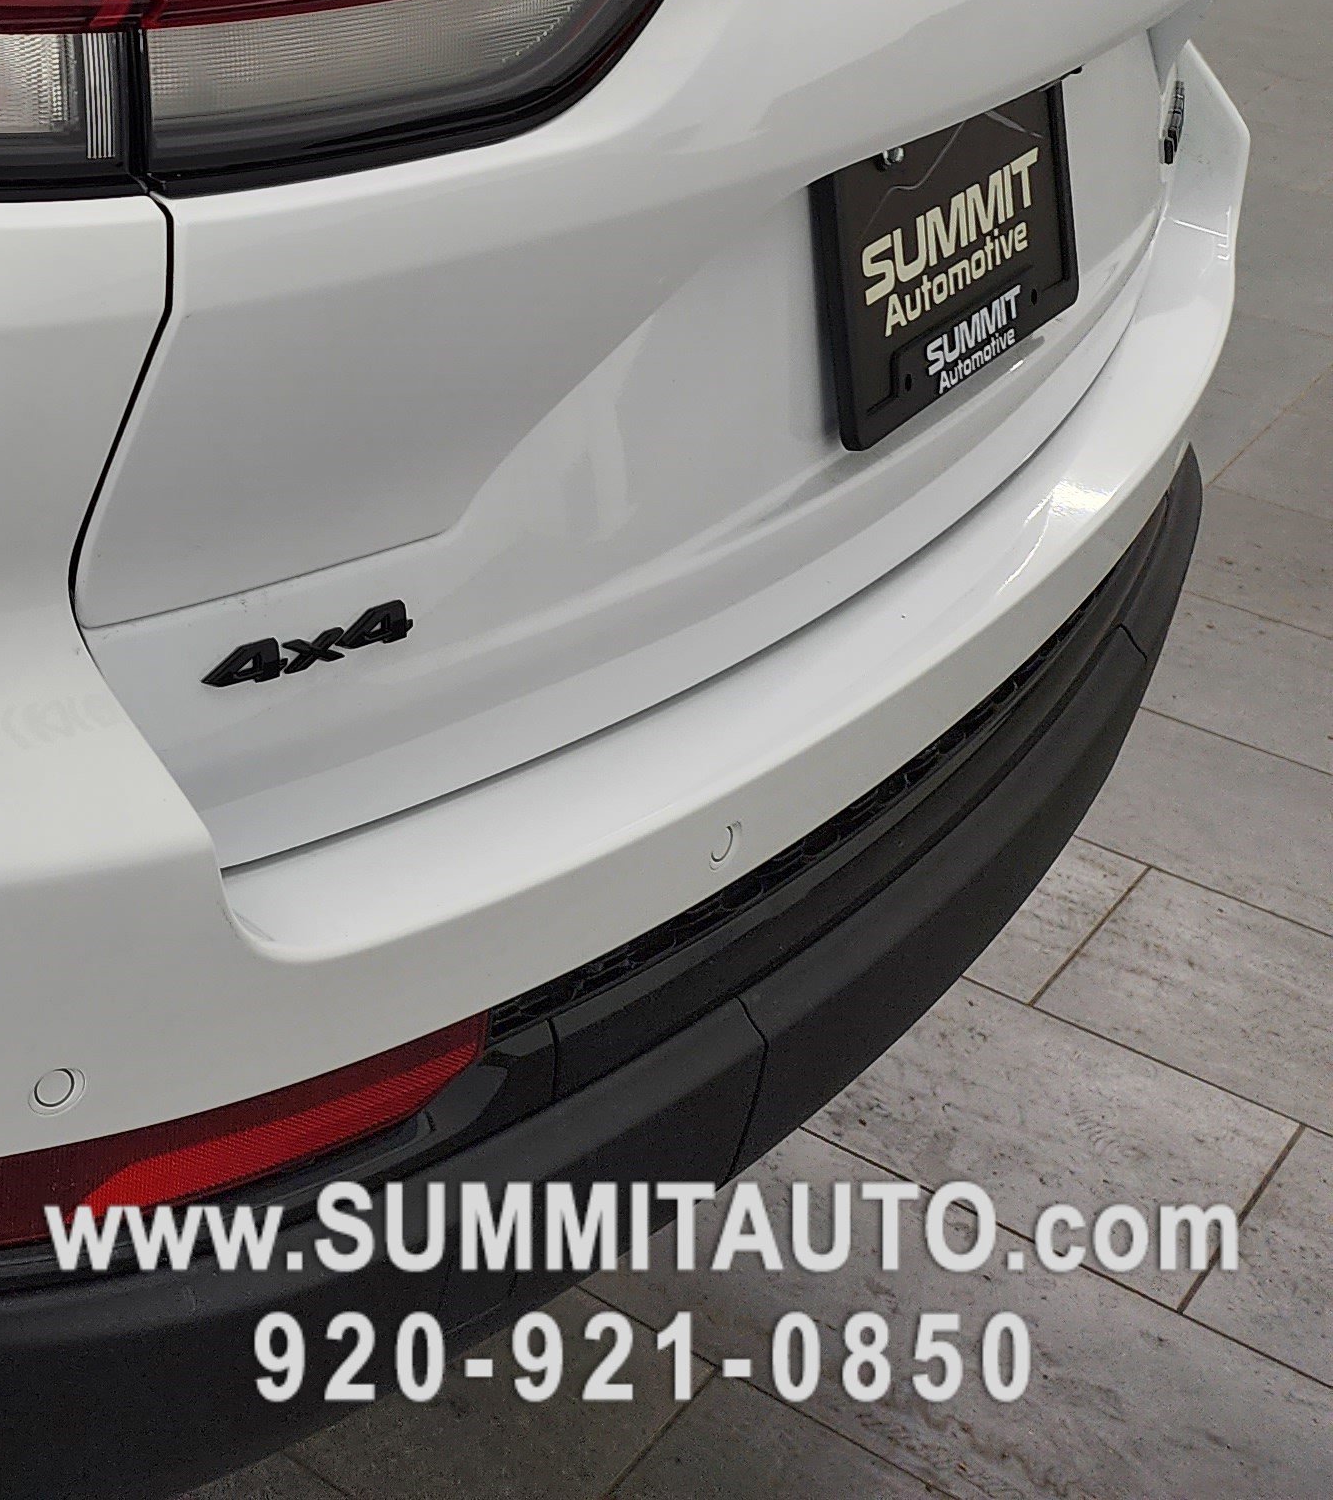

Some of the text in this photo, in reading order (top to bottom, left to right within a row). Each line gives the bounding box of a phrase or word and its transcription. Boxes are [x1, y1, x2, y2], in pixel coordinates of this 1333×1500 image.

[861, 146, 1039, 306] SUMMIT
[884, 220, 1029, 337] Automotive
[925, 284, 1021, 376] SUMMIT
[939, 327, 1016, 394] Automotive
